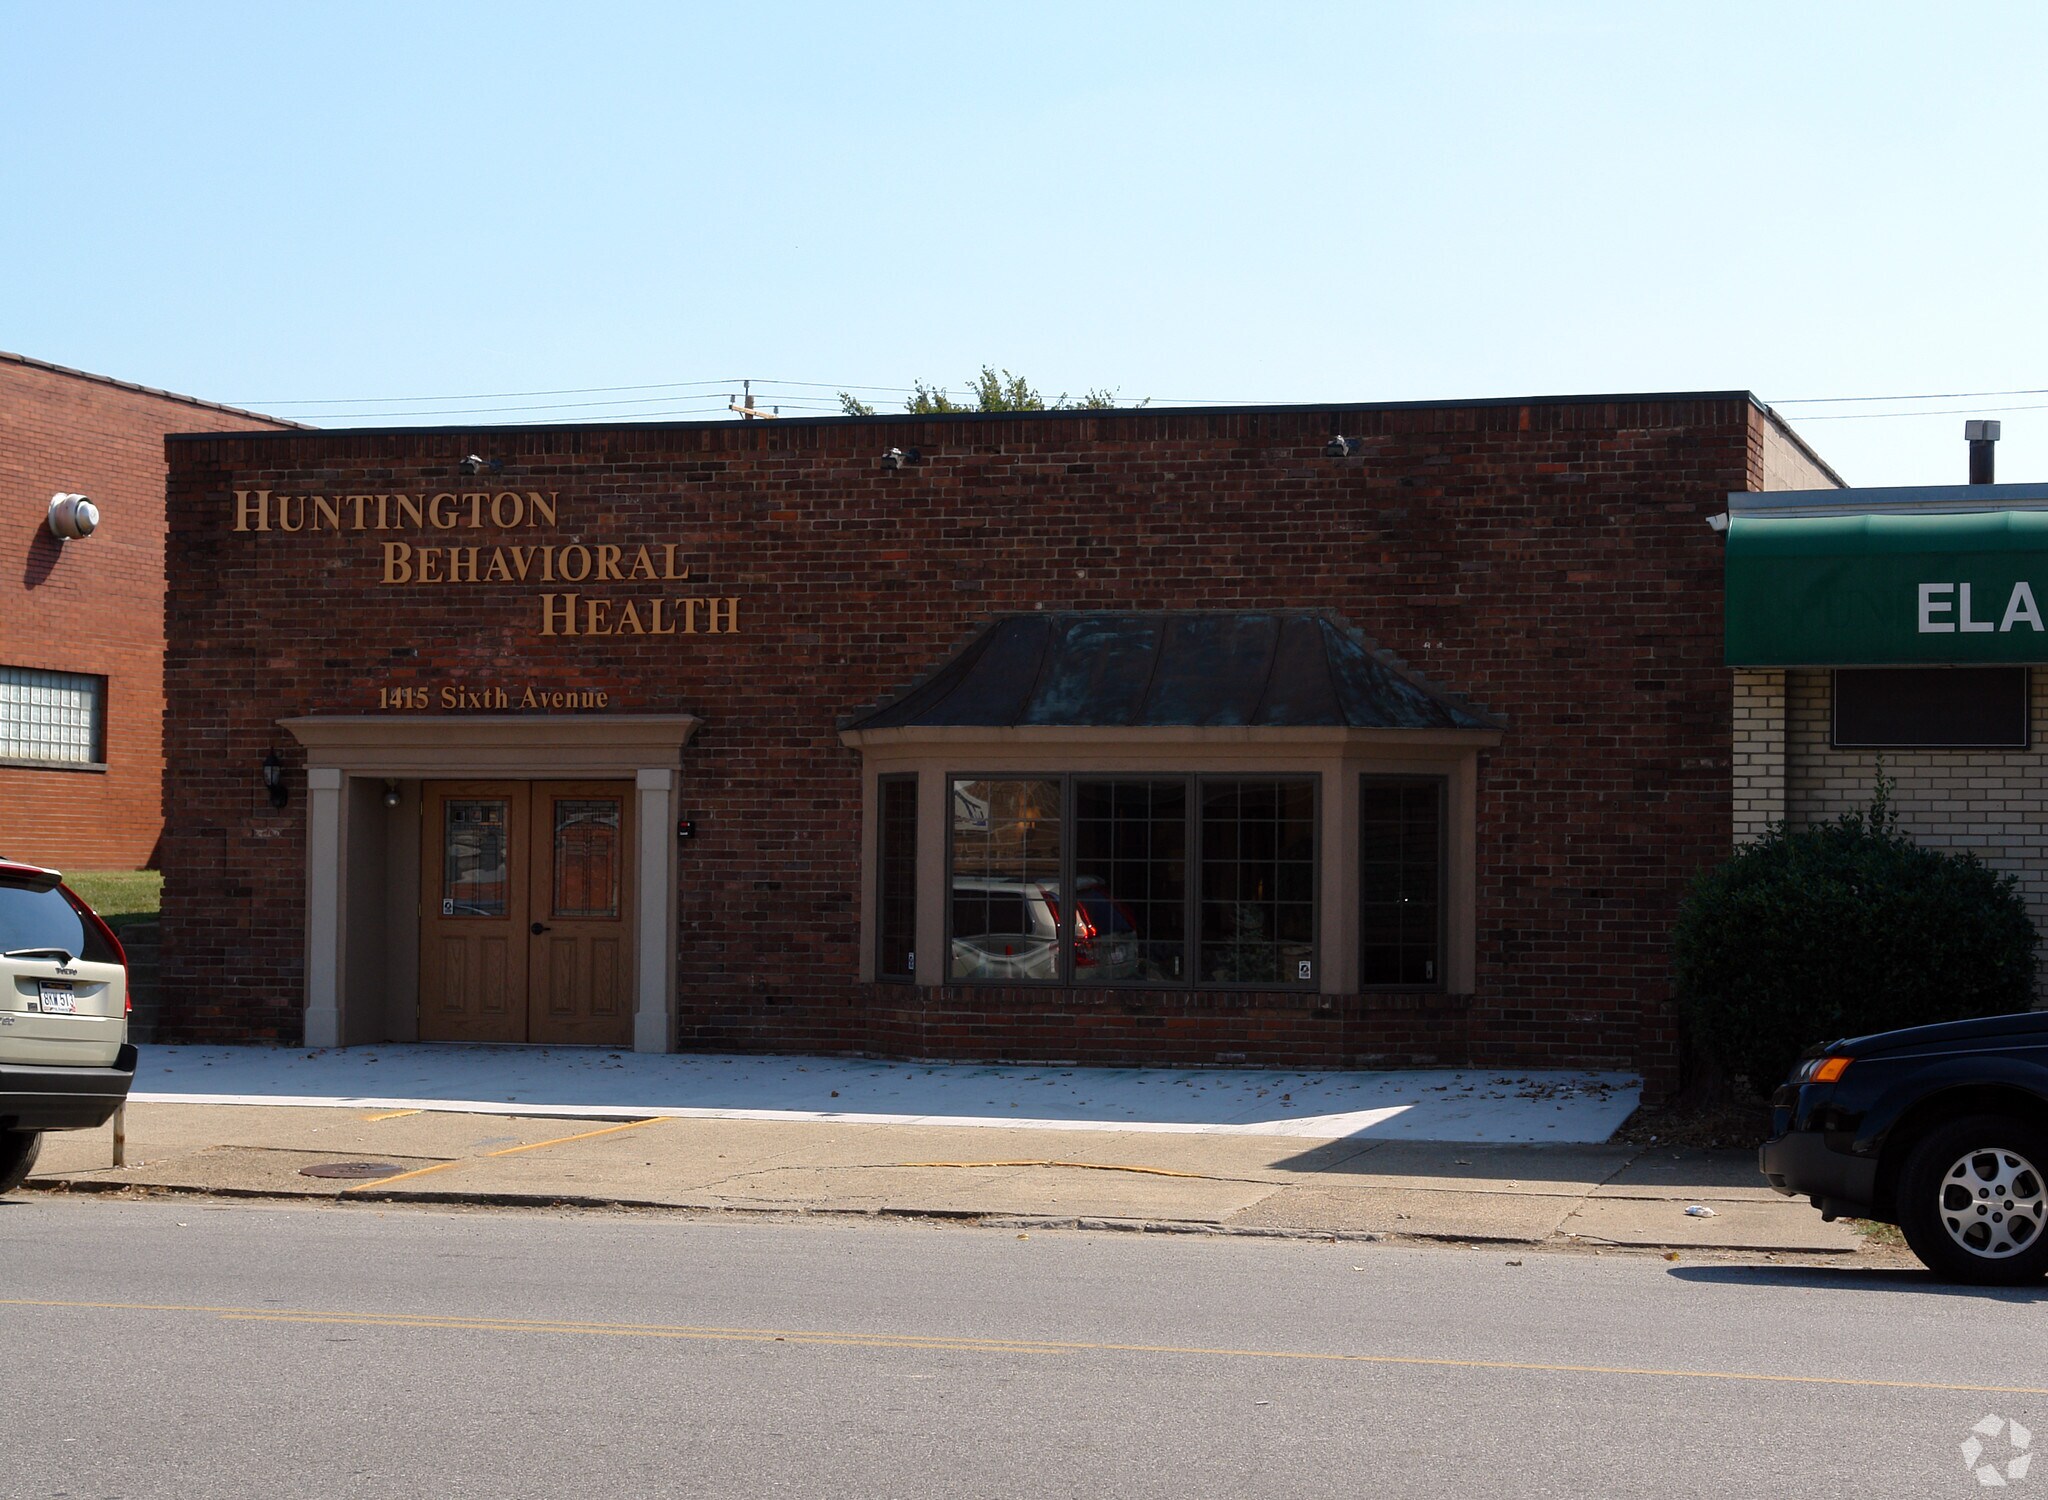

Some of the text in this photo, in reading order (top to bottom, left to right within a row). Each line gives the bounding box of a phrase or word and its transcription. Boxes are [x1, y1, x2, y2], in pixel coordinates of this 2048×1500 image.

[233, 489, 560, 532] HUNTINGTON
[380, 541, 690, 584] BEHAVIORAL
[539, 593, 742, 636] HEALTH
[1918, 581, 2046, 633] ELA
[378, 685, 608, 709] 1415 Sixth Avenue
